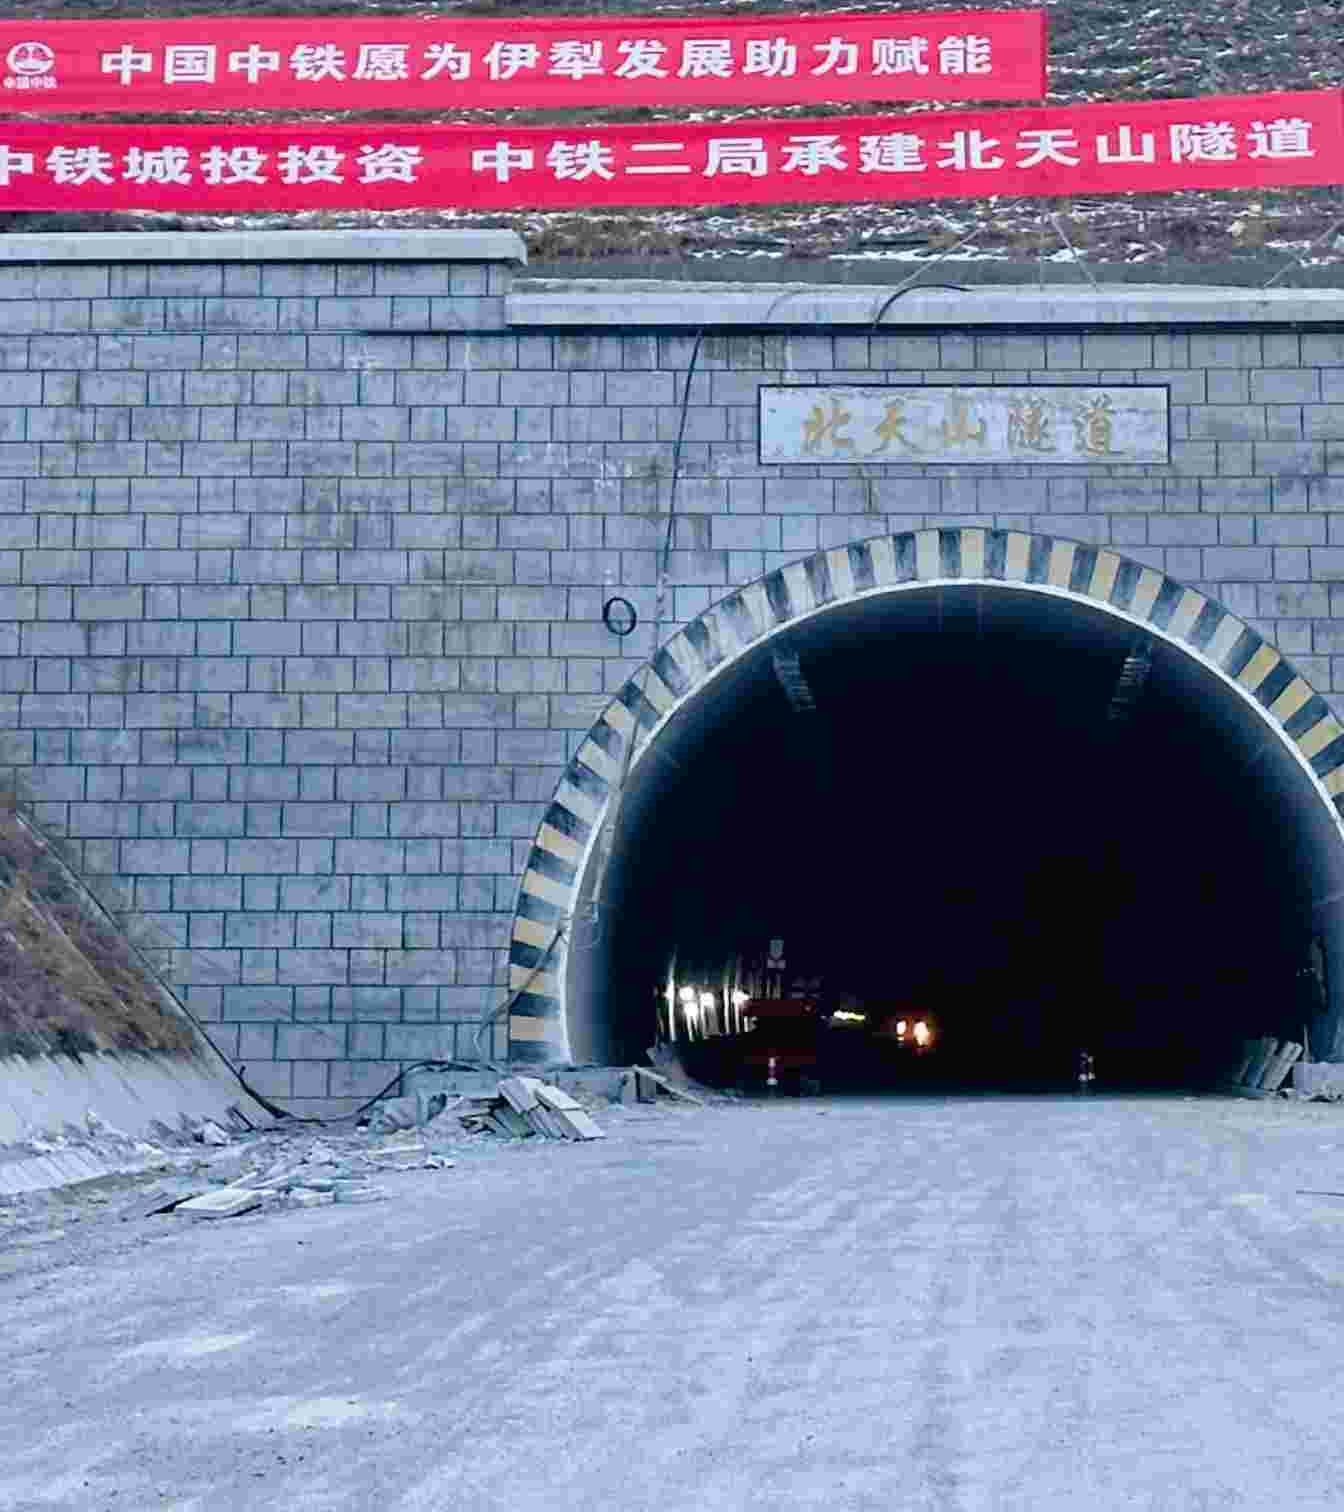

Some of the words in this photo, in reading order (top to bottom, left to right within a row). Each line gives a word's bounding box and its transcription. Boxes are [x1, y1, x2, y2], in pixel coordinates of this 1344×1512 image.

[101, 36, 992, 85] 中国中铁愿为伊犁发展助力赋能
[471, 118, 1317, 183] 中铁二局承建北天山隧道
[801, 392, 1128, 458] 北天山隧道
